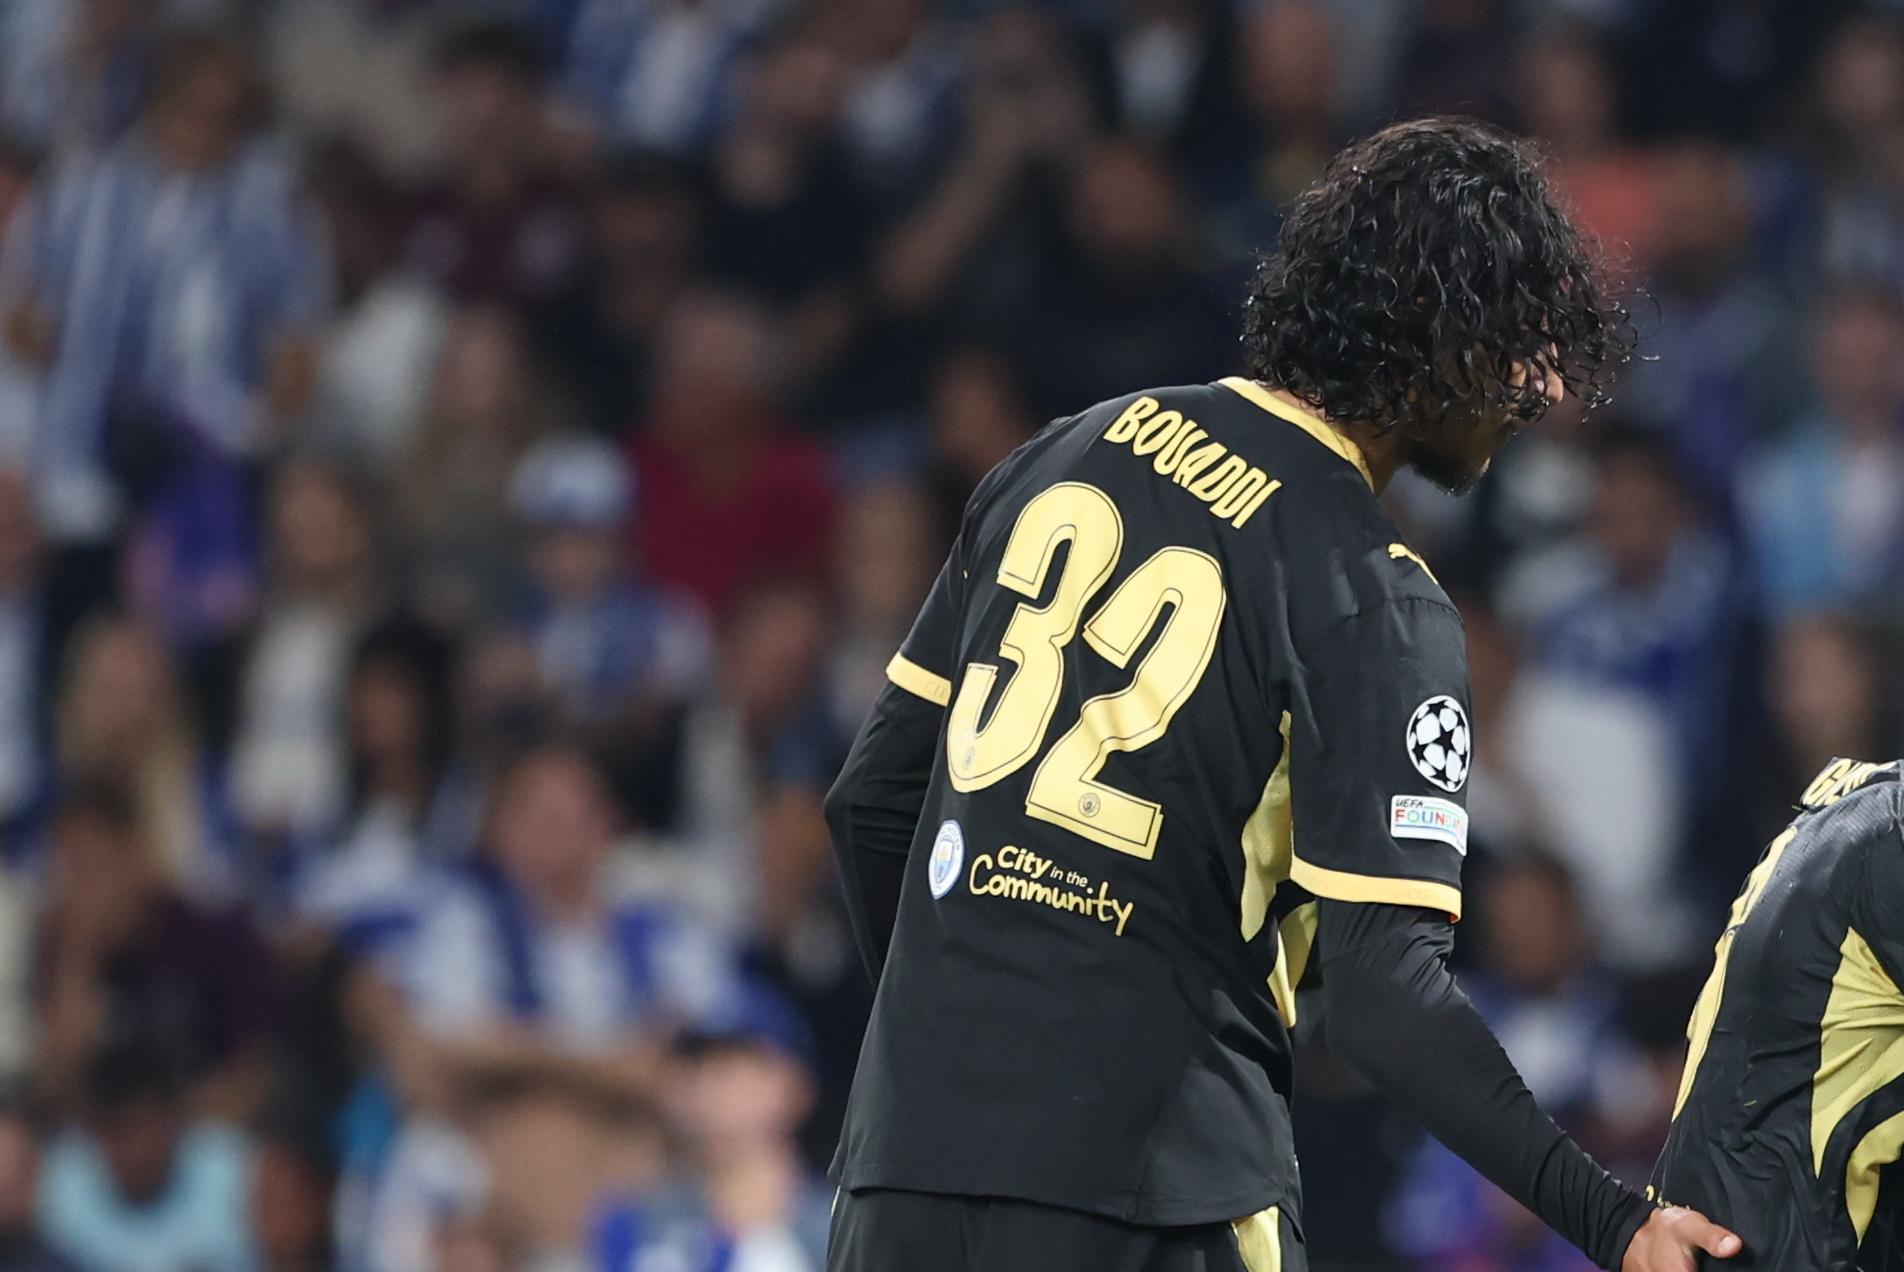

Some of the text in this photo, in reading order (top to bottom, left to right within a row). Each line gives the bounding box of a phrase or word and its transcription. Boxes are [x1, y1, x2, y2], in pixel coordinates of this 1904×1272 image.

[1102, 395, 1283, 530] BOUADDI
[946, 480, 1227, 861] 32
[968, 853, 1135, 937] Community
[997, 845, 1088, 888] City in the
